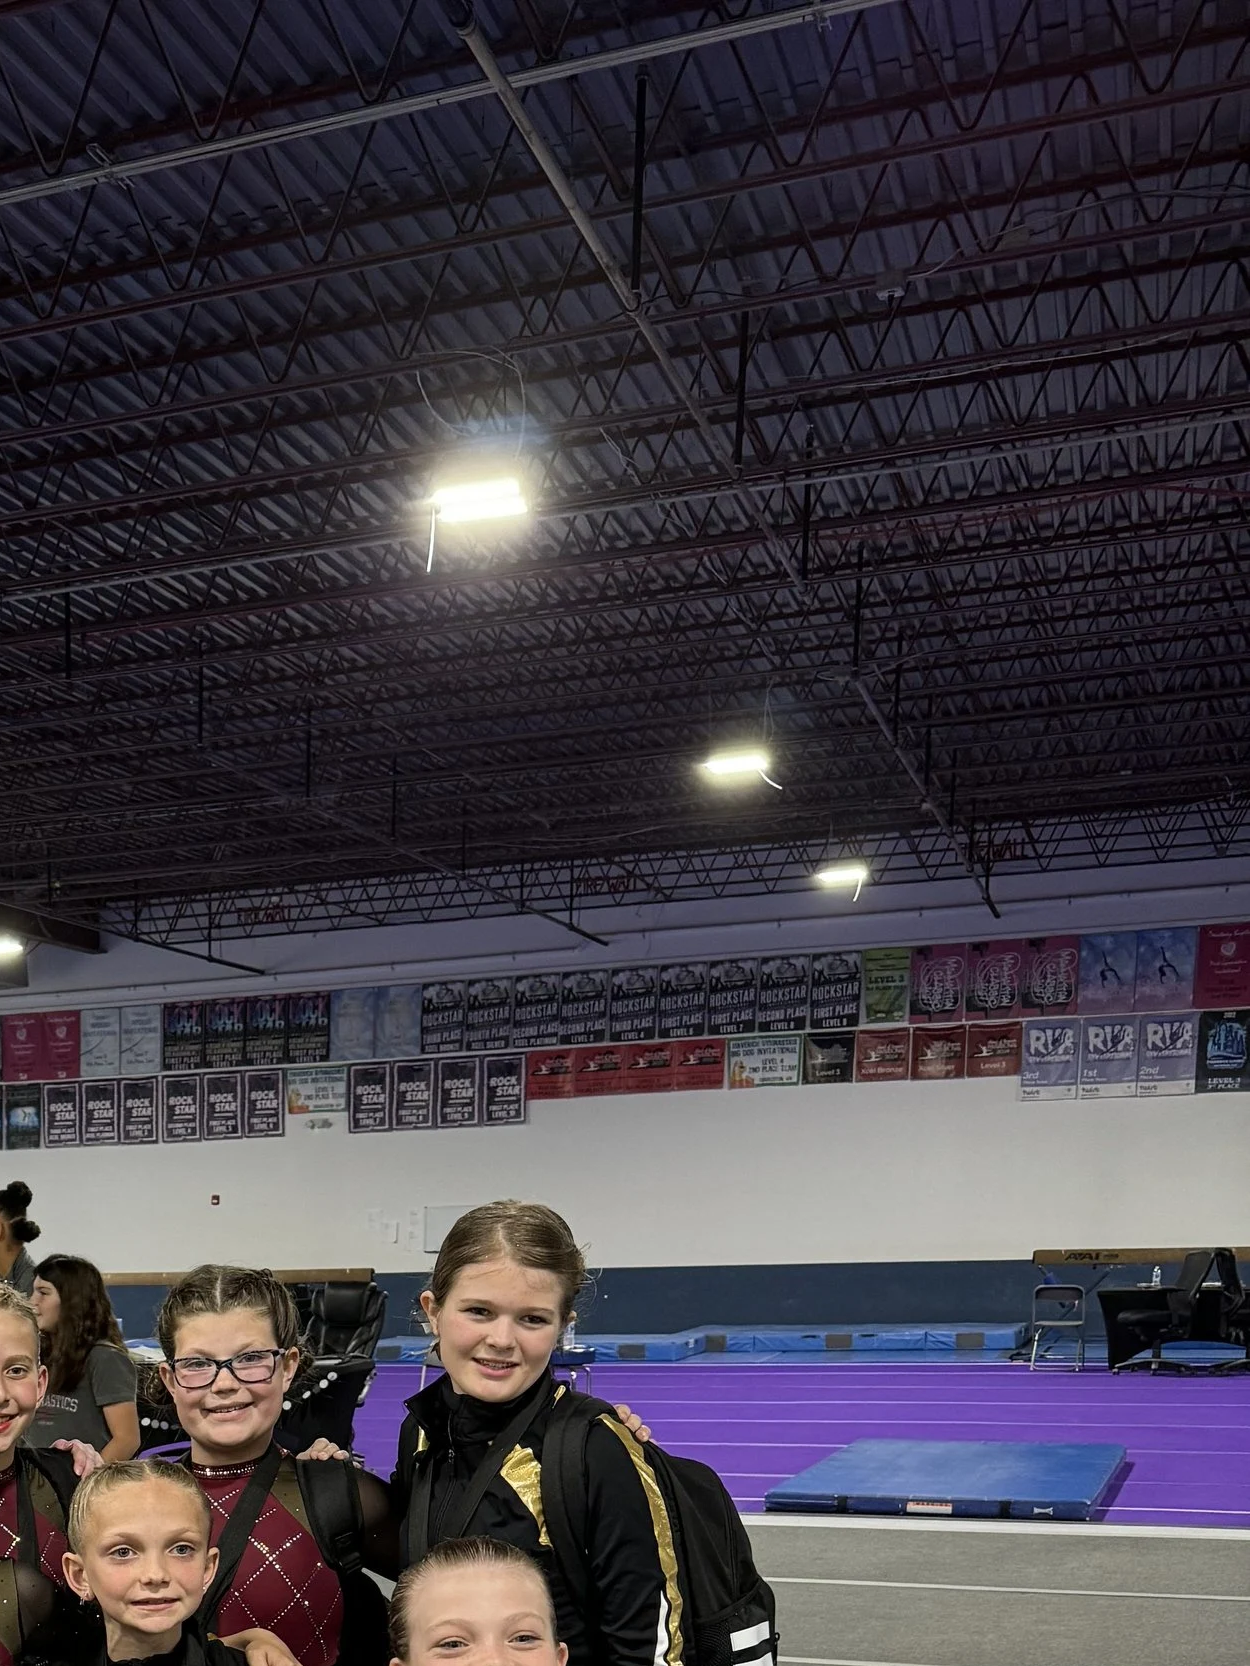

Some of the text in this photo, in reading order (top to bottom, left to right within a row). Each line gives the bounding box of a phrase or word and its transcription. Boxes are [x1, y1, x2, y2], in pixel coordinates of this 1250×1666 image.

[761, 986, 806, 1003] ROCKSTAR
[812, 982, 859, 1000] ROCKSTAR
[660, 992, 704, 1010] ROCKSTAR
[710, 989, 755, 1007] ROCKSTAR
[562, 1000, 605, 1017] ROCKSTAR
[612, 996, 655, 1014] ROCKSTAR
[468, 1007, 509, 1023] ROCKSTAR
[515, 1003, 557, 1020] ROCKSTAR
[758, 1007, 806, 1022] SECOND PLACE
[814, 1002, 857, 1019] FIRST PLACE
[423, 1009, 463, 1026] ROCKSTAR
[662, 1012, 702, 1028] FIRST PLACE
[711, 1009, 752, 1025] FIRST PLACE
[559, 1020, 606, 1035] SECOND PLACE
[612, 1017, 653, 1032] THIRD PLACE
[771, 1022, 788, 1030] LEVEL
[823, 1019, 841, 1027] LEVEL
[491, 1026, 510, 1037] PLACE
[514, 1022, 558, 1038] SECOND PLACE
[670, 1029, 688, 1037] LEVEL
[720, 1025, 738, 1033] LEVEL
[443, 1029, 462, 1040] PLACE
[622, 1032, 638, 1040] LEVEL
[1088, 1025, 1134, 1052] RVA
[1146, 1022, 1193, 1052] RVA
[1029, 1028, 1074, 1055] RVA
[757, 1047, 796, 1055] INVITATIONAL
[980, 1062, 999, 1070] Level
[1139, 1066, 1159, 1075] 2nd
[1023, 1071, 1039, 1079] 3rd
[1083, 1069, 1097, 1077] 1st
[444, 1079, 471, 1089] ROCK
[490, 1076, 517, 1087] ROCK
[356, 1085, 382, 1095] ROCK
[400, 1082, 426, 1092] ROCK
[496, 1086, 520, 1096] STAR
[210, 1093, 234, 1102] ROCK
[251, 1090, 275, 1100] ROCK
[406, 1091, 429, 1100] STAR
[450, 1088, 474, 1098] STAR
[126, 1099, 150, 1108] ROCK
[170, 1096, 193, 1105] ROCK
[362, 1094, 384, 1104] STAR
[50, 1103, 73, 1112] ROCK
[88, 1100, 111, 1109] ROCK
[175, 1105, 195, 1114] STAR
[215, 1102, 236, 1112] STAR
[256, 1100, 278, 1109] STAR
[55, 1112, 75, 1120] STAR
[93, 1109, 114, 1118] STAR
[132, 1107, 151, 1116] STAR
